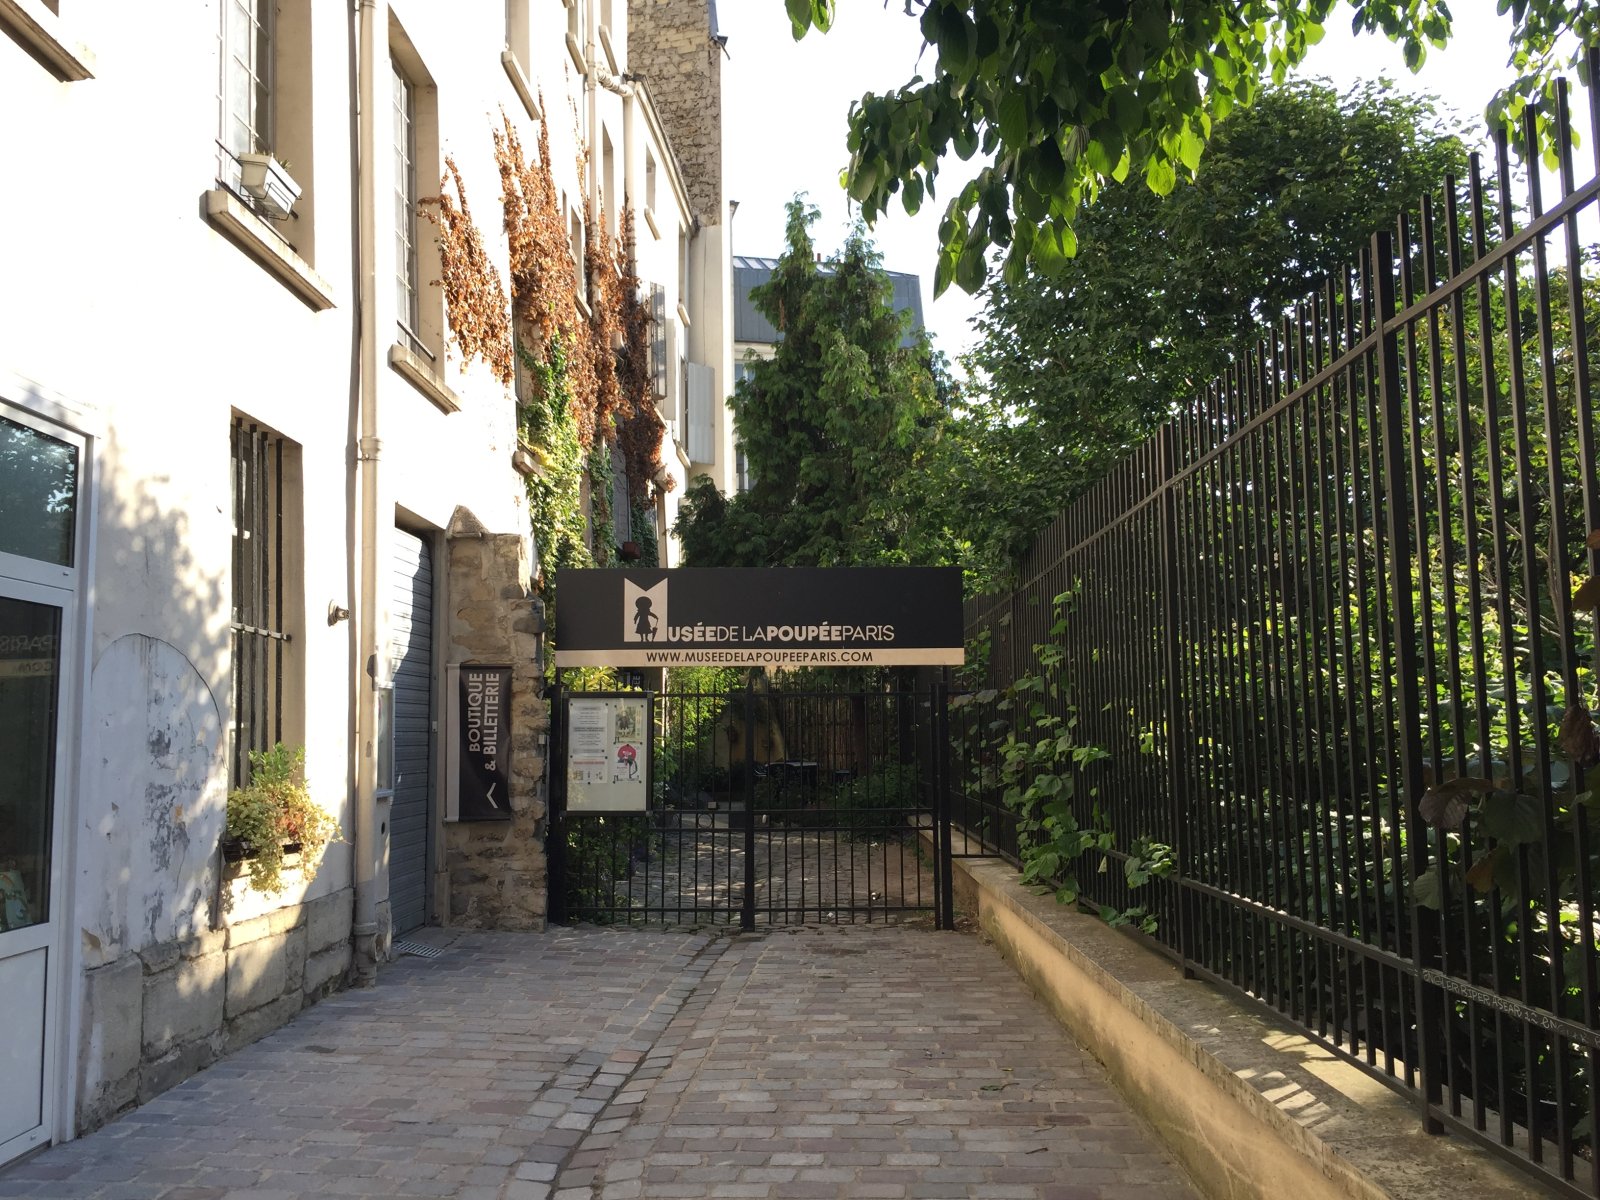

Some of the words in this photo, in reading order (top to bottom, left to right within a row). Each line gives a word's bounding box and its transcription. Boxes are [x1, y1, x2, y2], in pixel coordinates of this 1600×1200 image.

[646, 651, 873, 663] WWW.MUSEEDELAPOUPEEPARIS.COM
[467, 673, 483, 752] BOUTIQUE
[482, 673, 500, 755] BILLETTERIE
[484, 759, 496, 771] &
